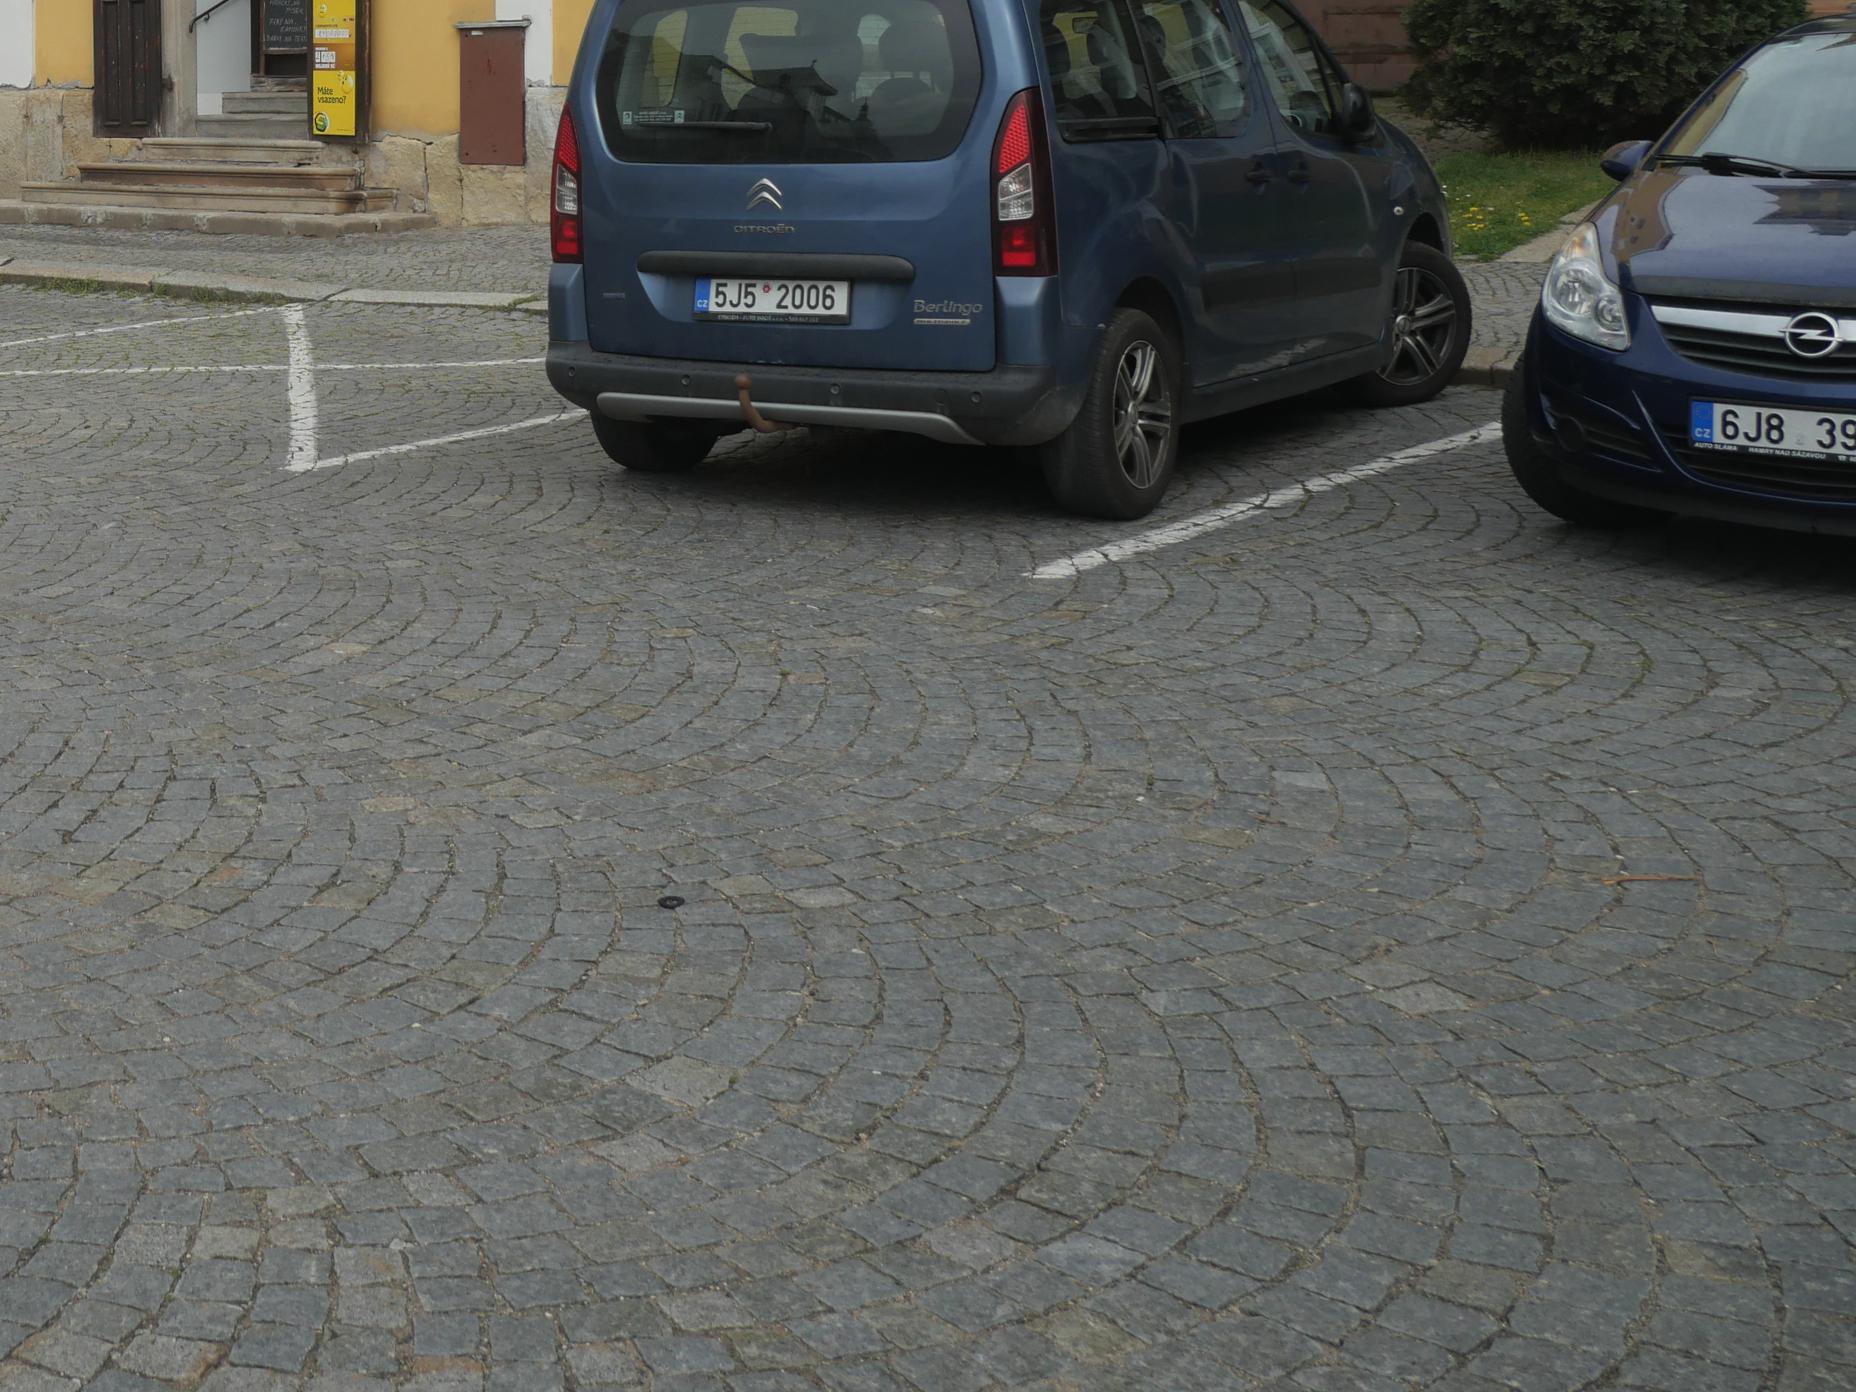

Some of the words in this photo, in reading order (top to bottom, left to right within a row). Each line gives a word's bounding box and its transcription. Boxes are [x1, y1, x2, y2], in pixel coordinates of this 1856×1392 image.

[318, 87, 334, 96] Máte
[318, 96, 347, 105] vsazeno?
[715, 282, 757, 308] 5J5
[776, 284, 836, 311] 2006
[697, 299, 708, 307] CZ
[913, 299, 984, 315] Berlingo
[1721, 409, 1785, 445] 6J8
[1695, 427, 1712, 439] CZ
[1694, 441, 1713, 449] AUTO
